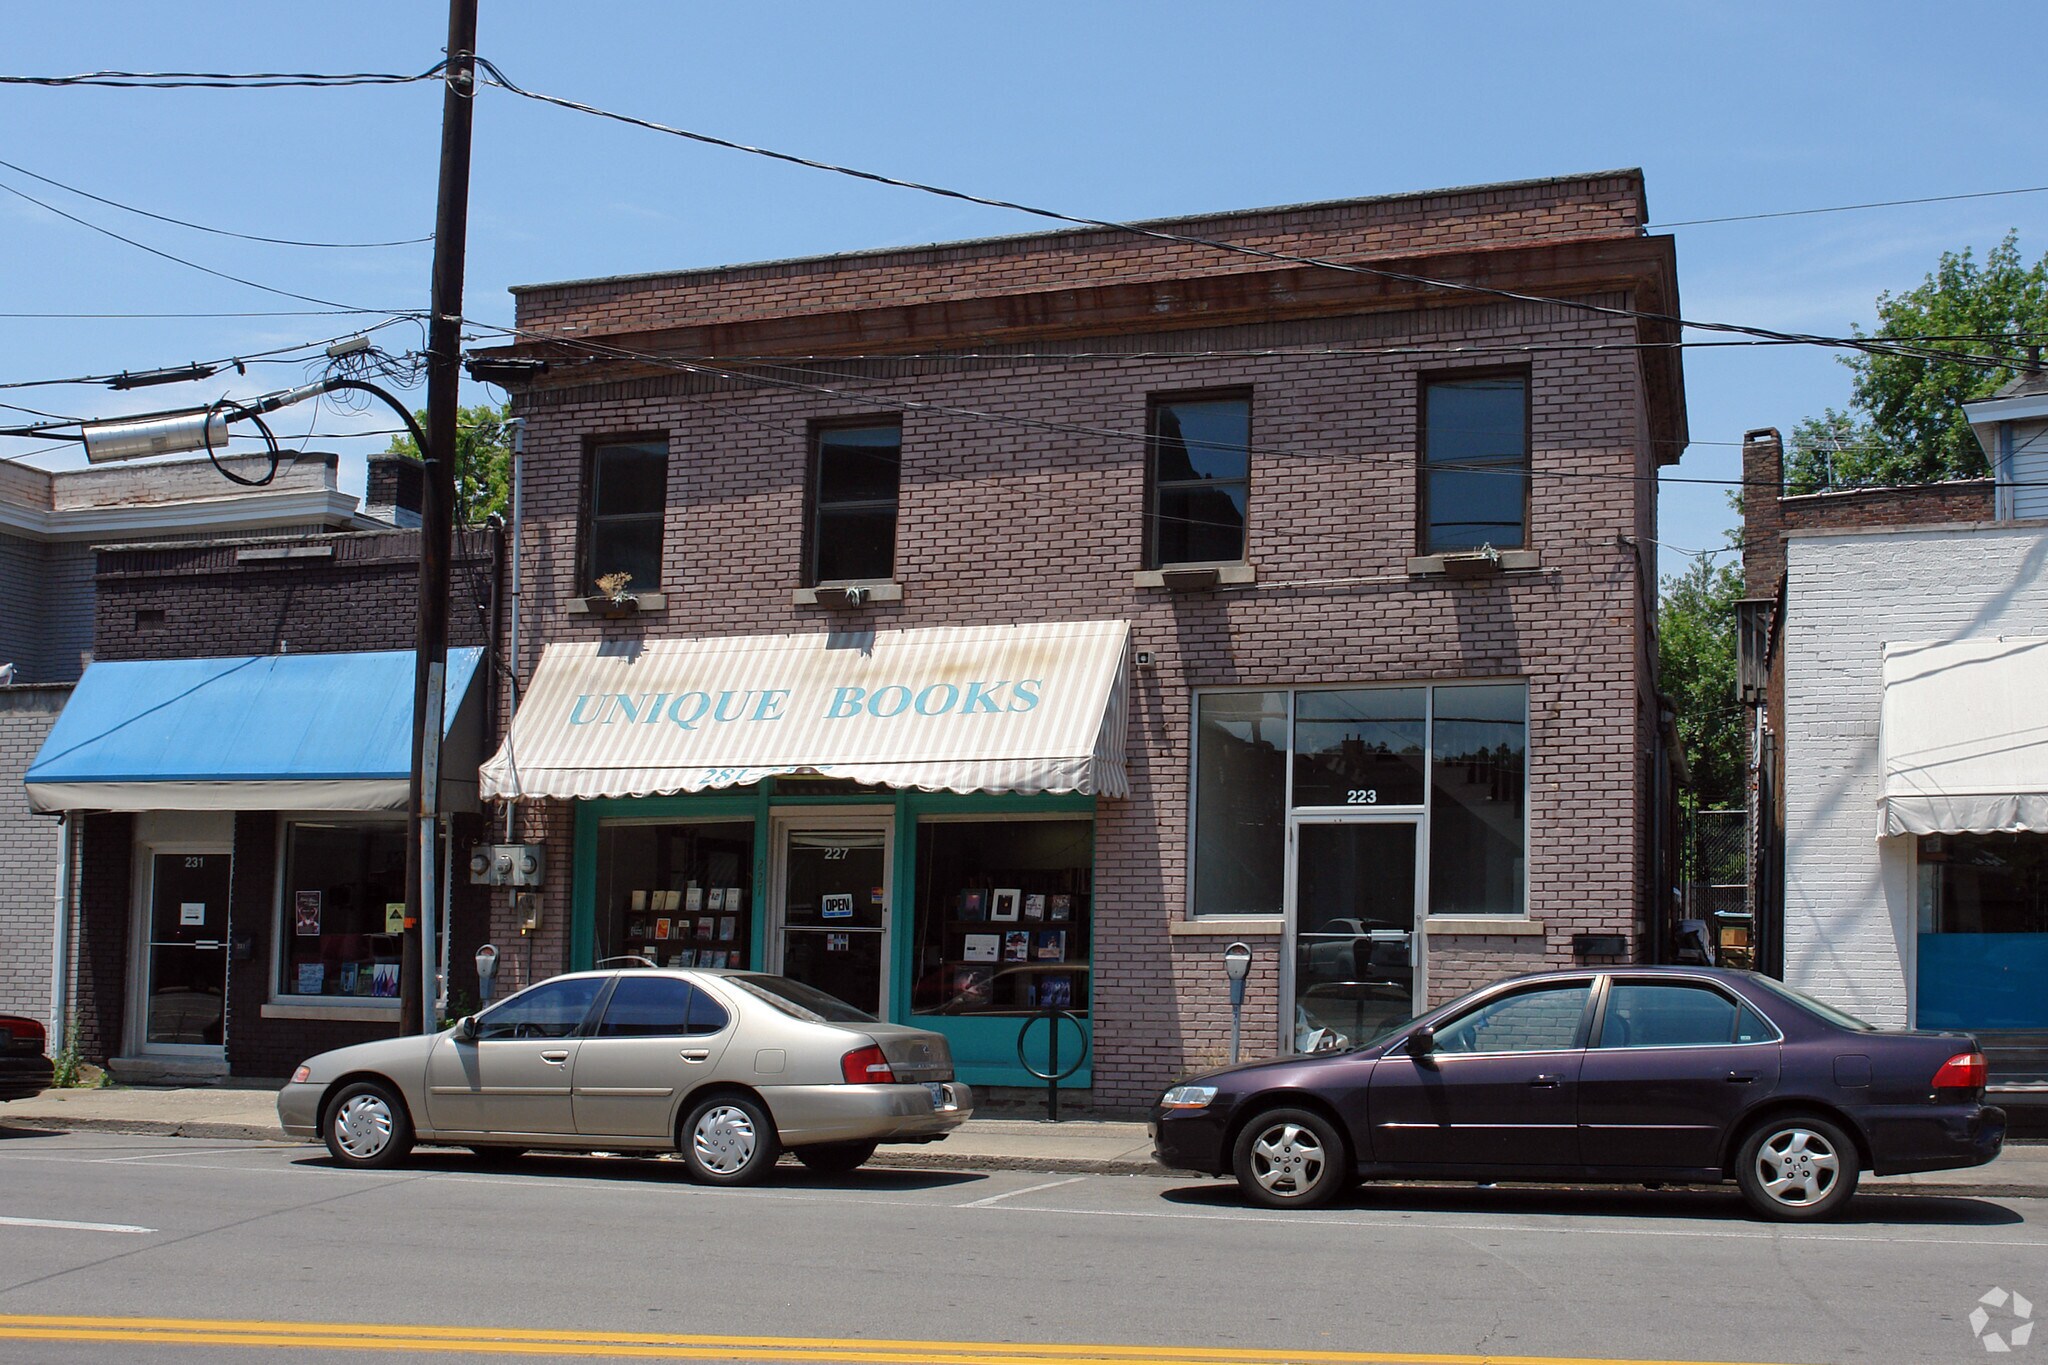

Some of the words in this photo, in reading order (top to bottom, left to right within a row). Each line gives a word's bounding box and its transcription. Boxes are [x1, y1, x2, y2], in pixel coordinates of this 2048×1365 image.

[568, 688, 792, 730] UNIQUE
[823, 679, 1044, 720] BOOKS
[1347, 789, 1377, 804] 223
[824, 847, 850, 860] 227
[185, 856, 204, 868] 231
[825, 897, 850, 912] OPEN
